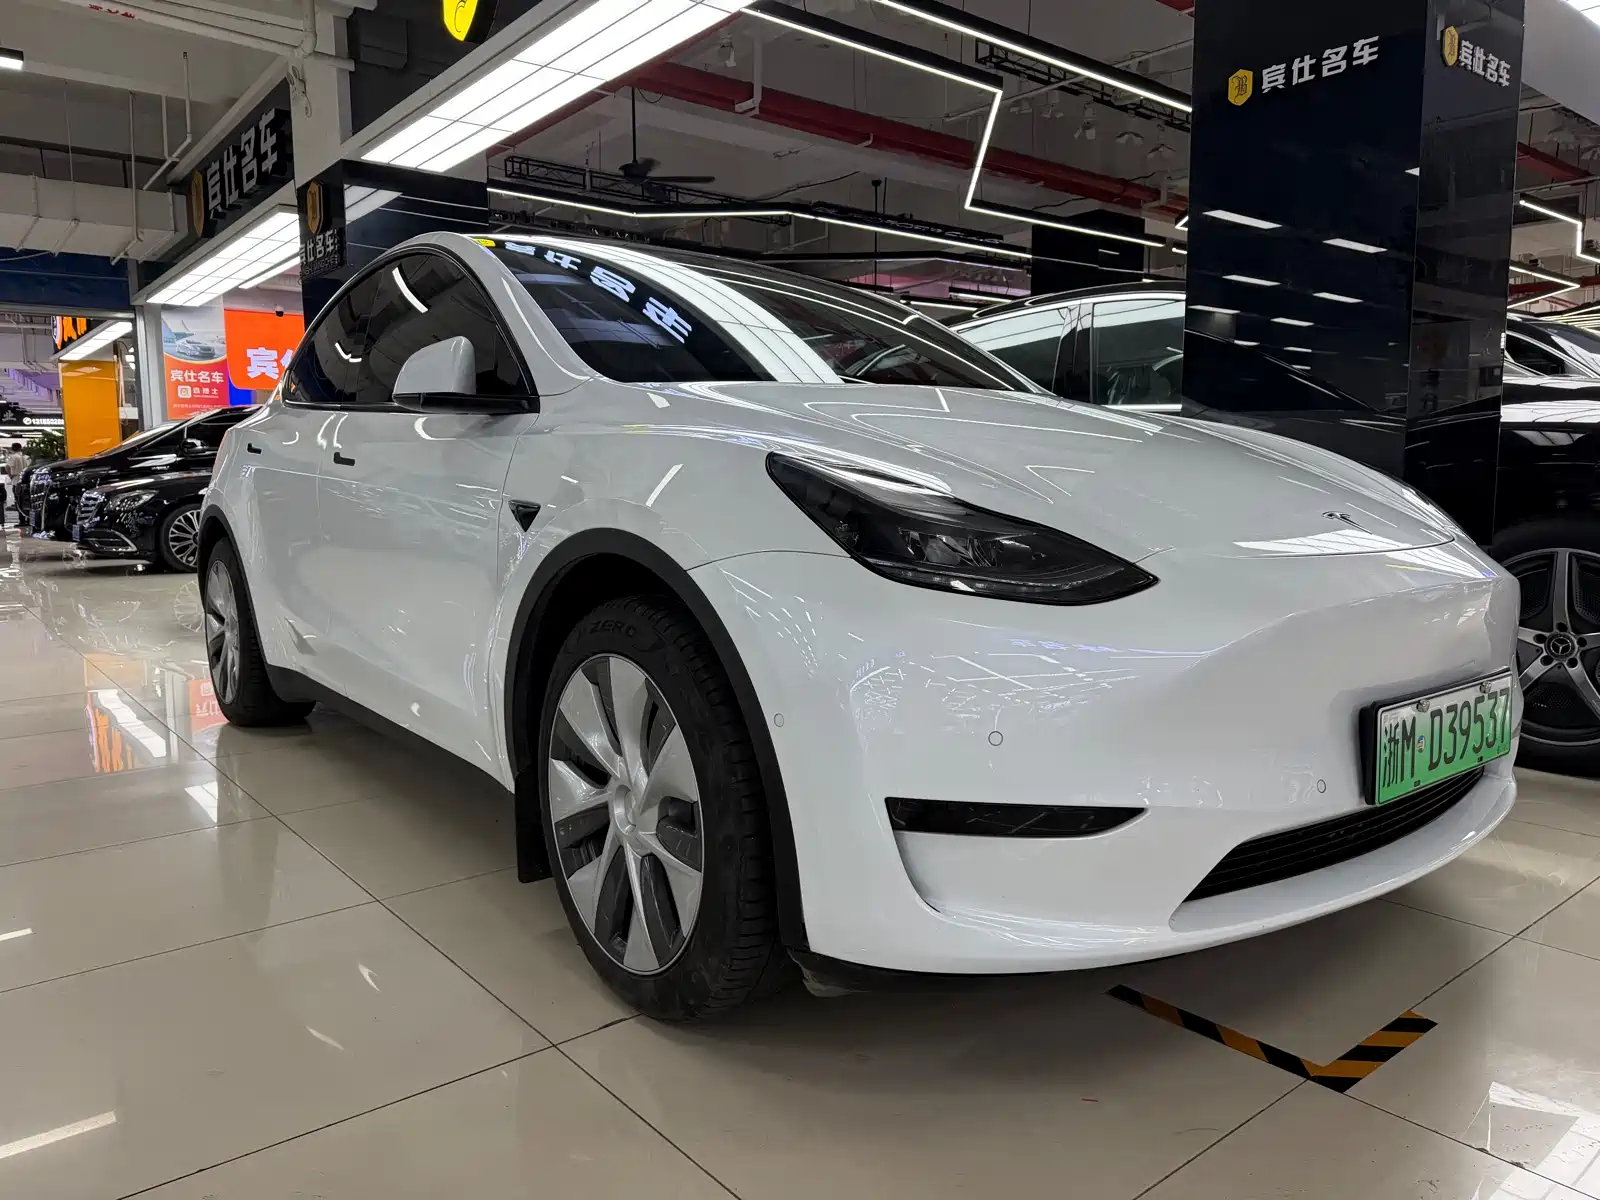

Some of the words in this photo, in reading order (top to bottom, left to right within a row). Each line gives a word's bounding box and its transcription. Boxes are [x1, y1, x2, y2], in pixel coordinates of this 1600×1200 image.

[1261, 35, 1380, 94] 宾仕名车
[1458, 40, 1511, 87] 宾仕名车
[206, 108, 278, 220] 宾仕名车
[170, 369, 224, 384] 宾仕名车
[589, 619, 636, 638] ZERO
